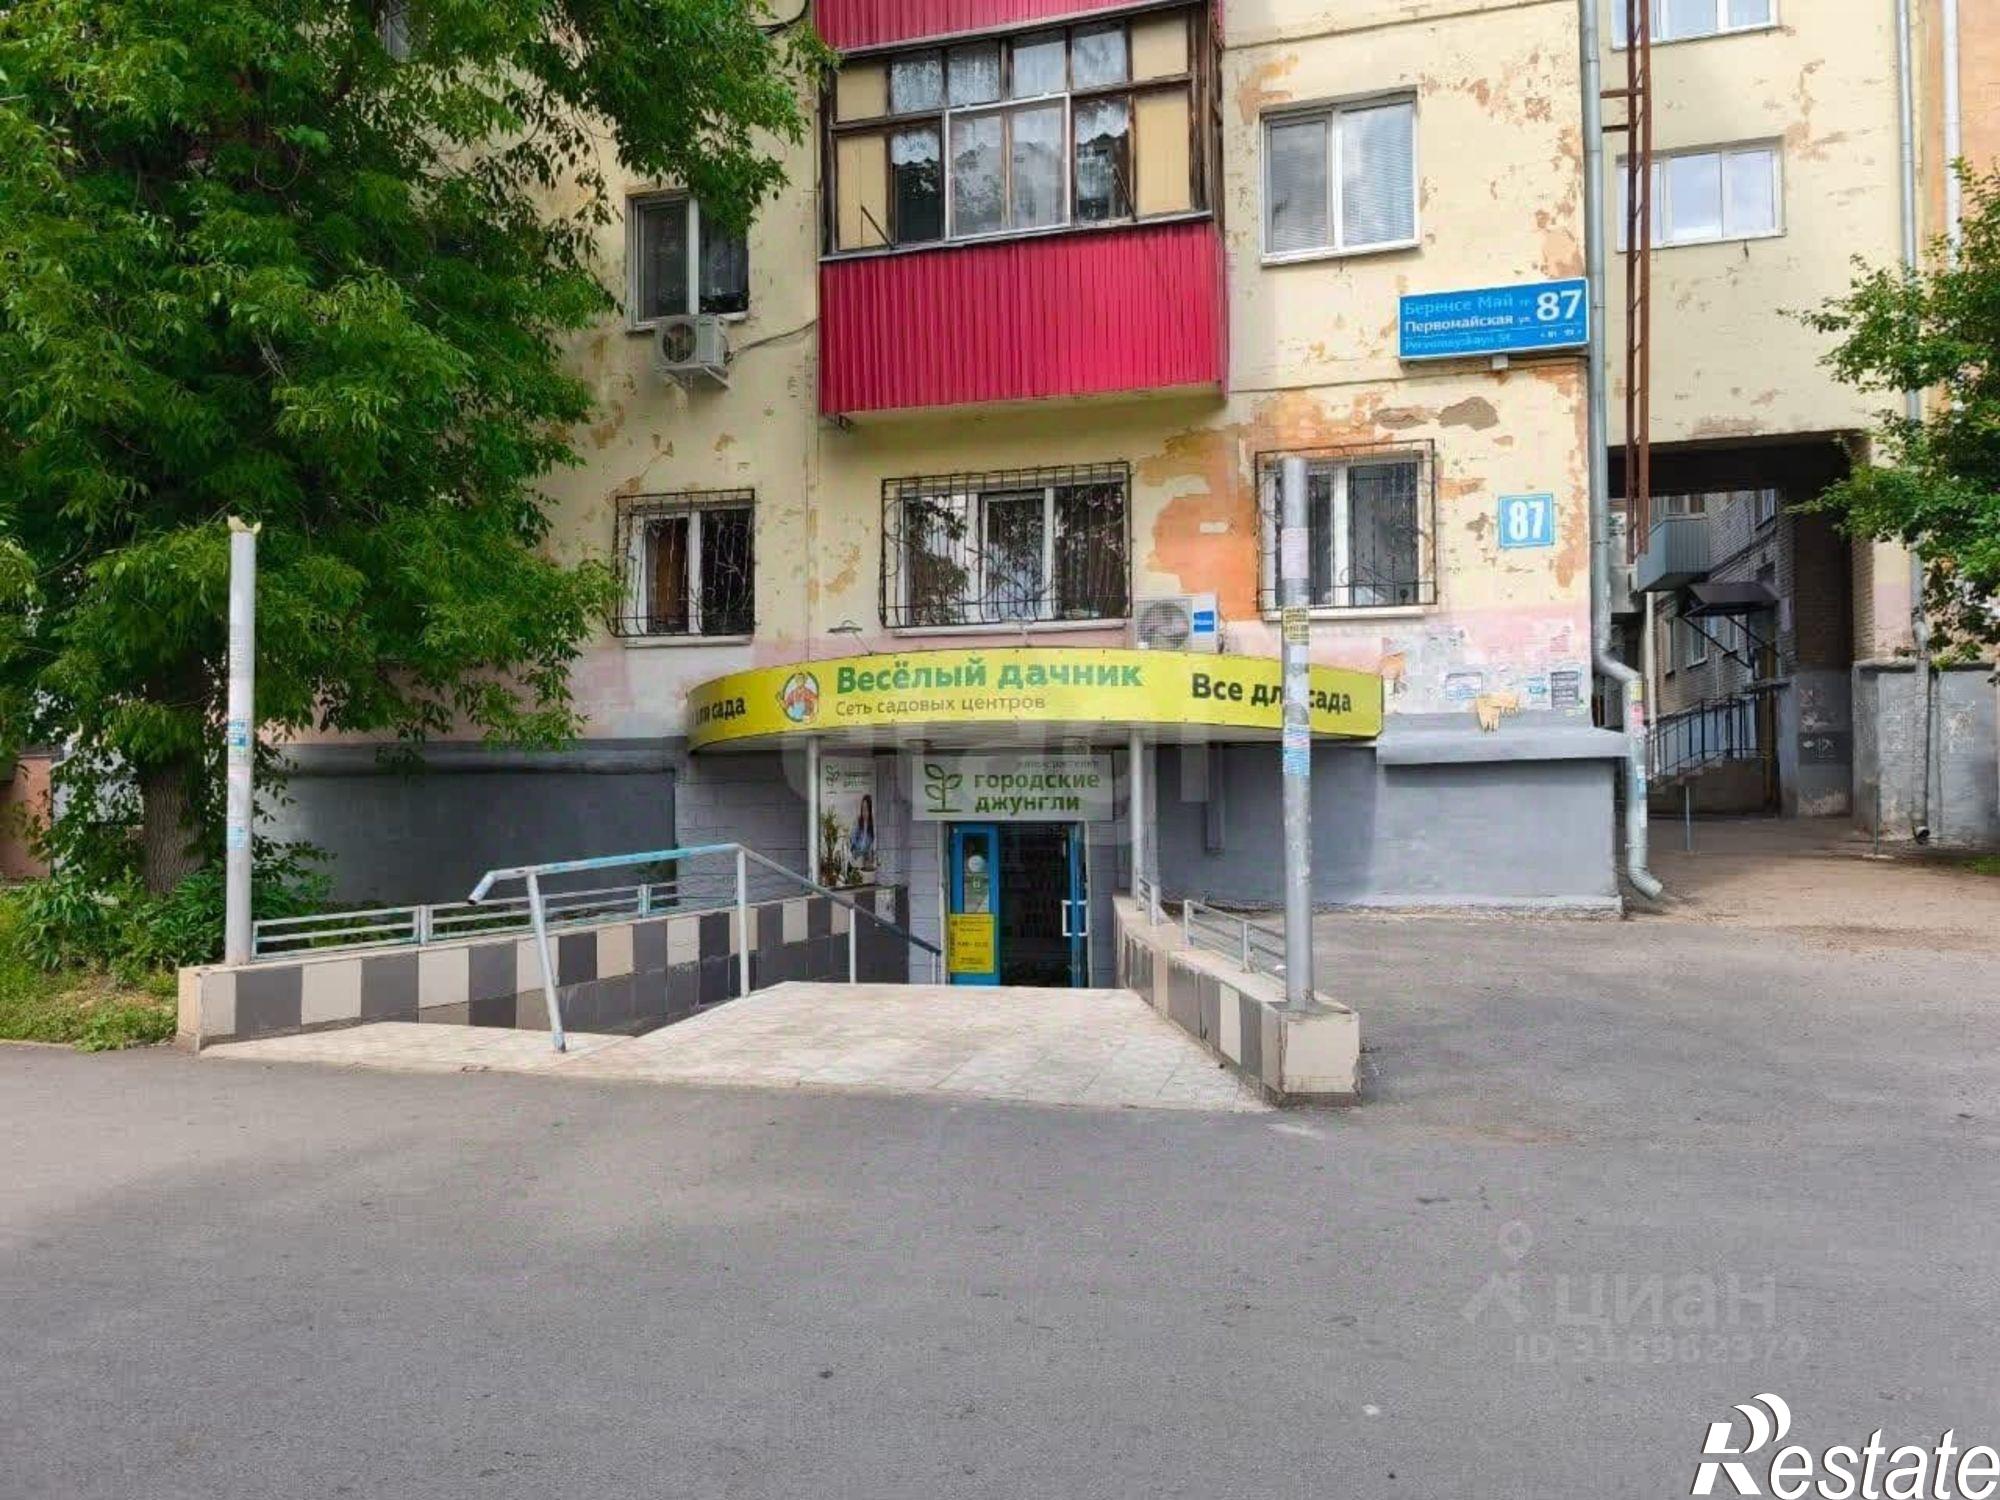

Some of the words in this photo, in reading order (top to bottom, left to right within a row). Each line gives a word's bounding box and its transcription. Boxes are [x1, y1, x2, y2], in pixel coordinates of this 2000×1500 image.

[1477, 292, 1514, 309] Май
[1536, 288, 1583, 322] 87
[1404, 315, 1514, 335] Первомайская
[1507, 500, 1545, 540] 87
[836, 657, 987, 694] Весёлый
[997, 661, 1143, 692] дачник
[1191, 672, 1243, 703] Все
[1250, 683, 1284, 708] дл
[711, 696, 746, 721] сада
[835, 699, 873, 717] Сеть
[876, 697, 956, 715] садовых
[961, 695, 1046, 714] центров
[974, 773, 1101, 793] городские
[974, 795, 1081, 816] джунгли
